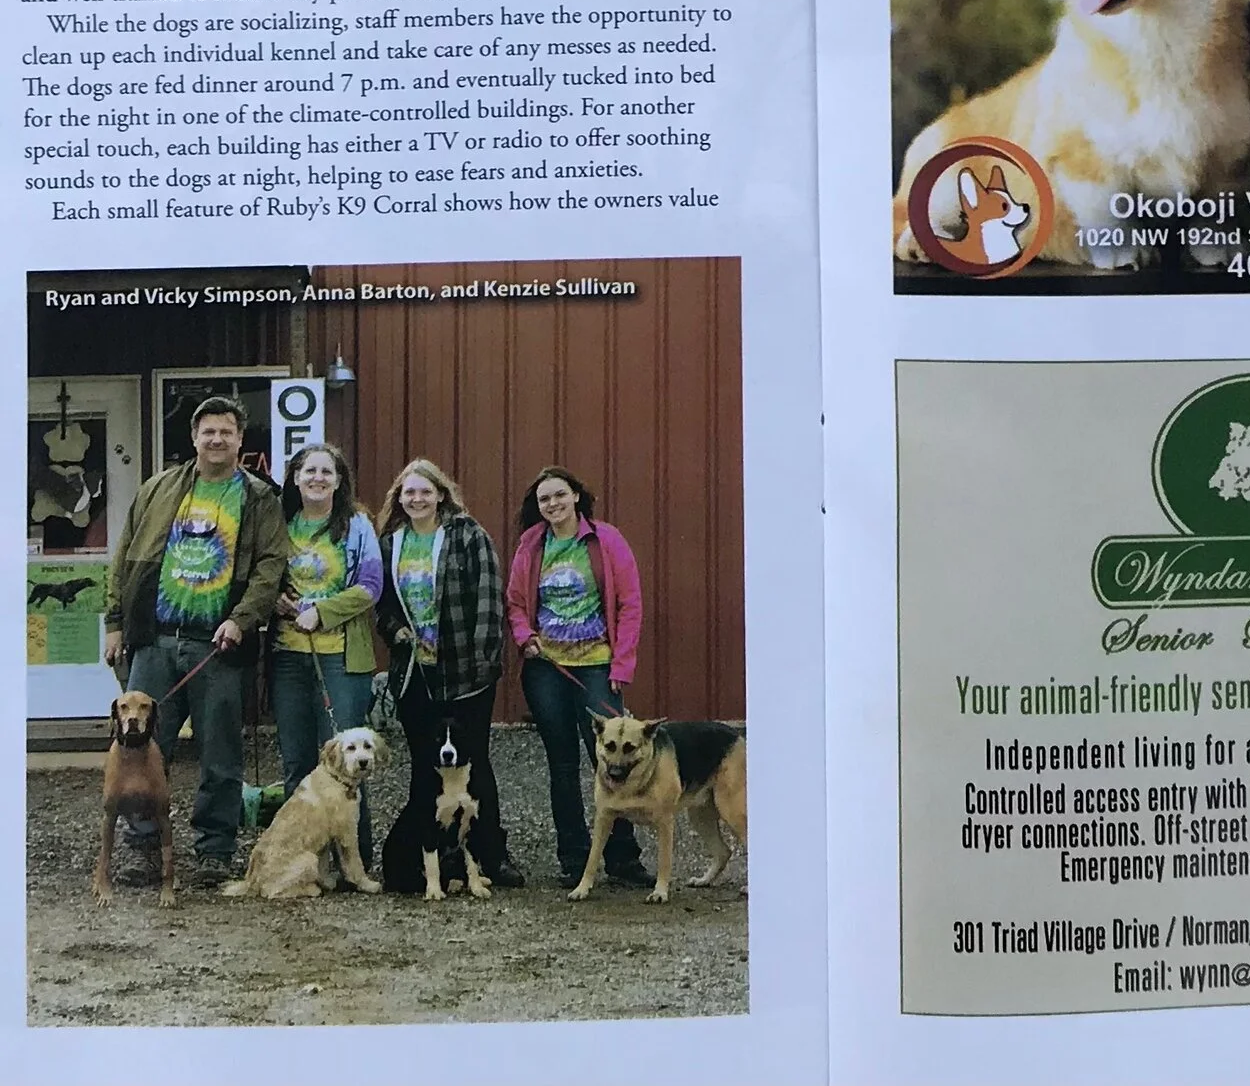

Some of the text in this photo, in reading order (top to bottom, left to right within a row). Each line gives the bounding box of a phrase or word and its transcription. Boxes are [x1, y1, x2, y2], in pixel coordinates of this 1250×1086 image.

[1110, 192, 1236, 220] Okoboji
[1074, 229, 1125, 246] 1020
[1130, 229, 1170, 246] NW
[1177, 228, 1241, 244] 192nd
[46, 279, 636, 309] Ryan and Vicky Simpson, Anna Barton, and Kenzie Sullivan
[1101, 614, 1214, 655] Senior
[956, 677, 1009, 716] Your
[1020, 674, 1202, 716] animal-friendly
[985, 738, 1125, 773] Independent
[1134, 737, 1196, 770] living
[1205, 736, 1236, 766] for
[965, 781, 1066, 813] Controlled
[1074, 785, 1140, 811] access
[1148, 782, 1198, 813] entry
[1205, 780, 1246, 808] with
[962, 820, 1013, 851] dryer
[1021, 817, 1145, 848] connections.
[1154, 813, 1248, 844] Off-street
[1061, 852, 1165, 886] Emergency
[954, 922, 985, 954] 301
[992, 921, 1039, 953] Triad
[1044, 919, 1106, 954] Village
[1113, 918, 1159, 949] Drive
[1114, 962, 1172, 992] Email:
